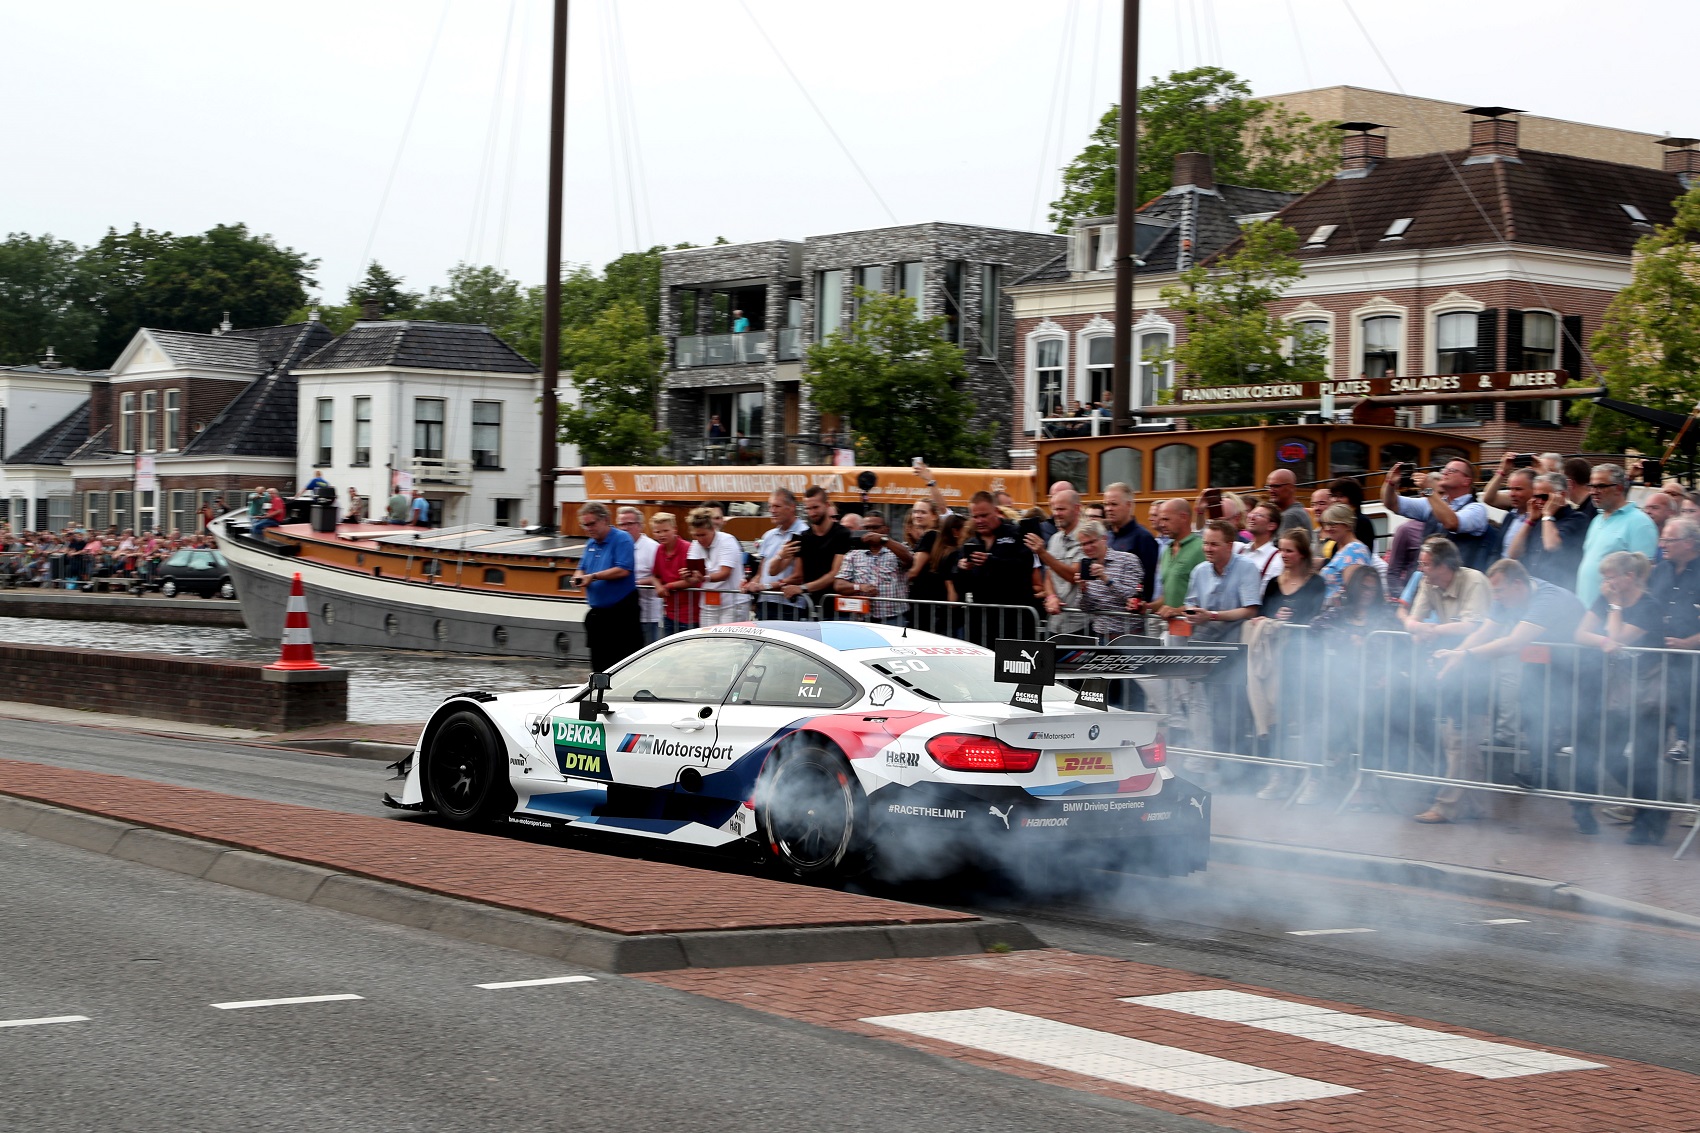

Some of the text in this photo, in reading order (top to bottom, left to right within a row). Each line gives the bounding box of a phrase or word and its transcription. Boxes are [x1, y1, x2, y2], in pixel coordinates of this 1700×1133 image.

[1182, 372, 1557, 400] PANNENKOEKEN PLATES SALADES & MEER
[712, 626, 765, 635] KLINGMANN
[887, 659, 930, 674] 50
[1089, 655, 1227, 664] PERFORMANCE
[1003, 660, 1031, 675] PUMA
[797, 686, 822, 698] KLI
[1015, 691, 1038, 699] BECKER
[1081, 690, 1104, 698] BECKER
[531, 715, 552, 737] 50
[556, 722, 601, 745] DEKRA
[1043, 732, 1075, 740] Motorsport
[652, 738, 733, 762] Motorsport
[886, 750, 906, 764] H&R
[509, 758, 525, 766] PUMA
[565, 752, 601, 773] DTM
[1064, 757, 1106, 771] DHL
[888, 804, 966, 819] #RACETHELIMIT
[1063, 801, 1145, 812] BMW Driving Experience
